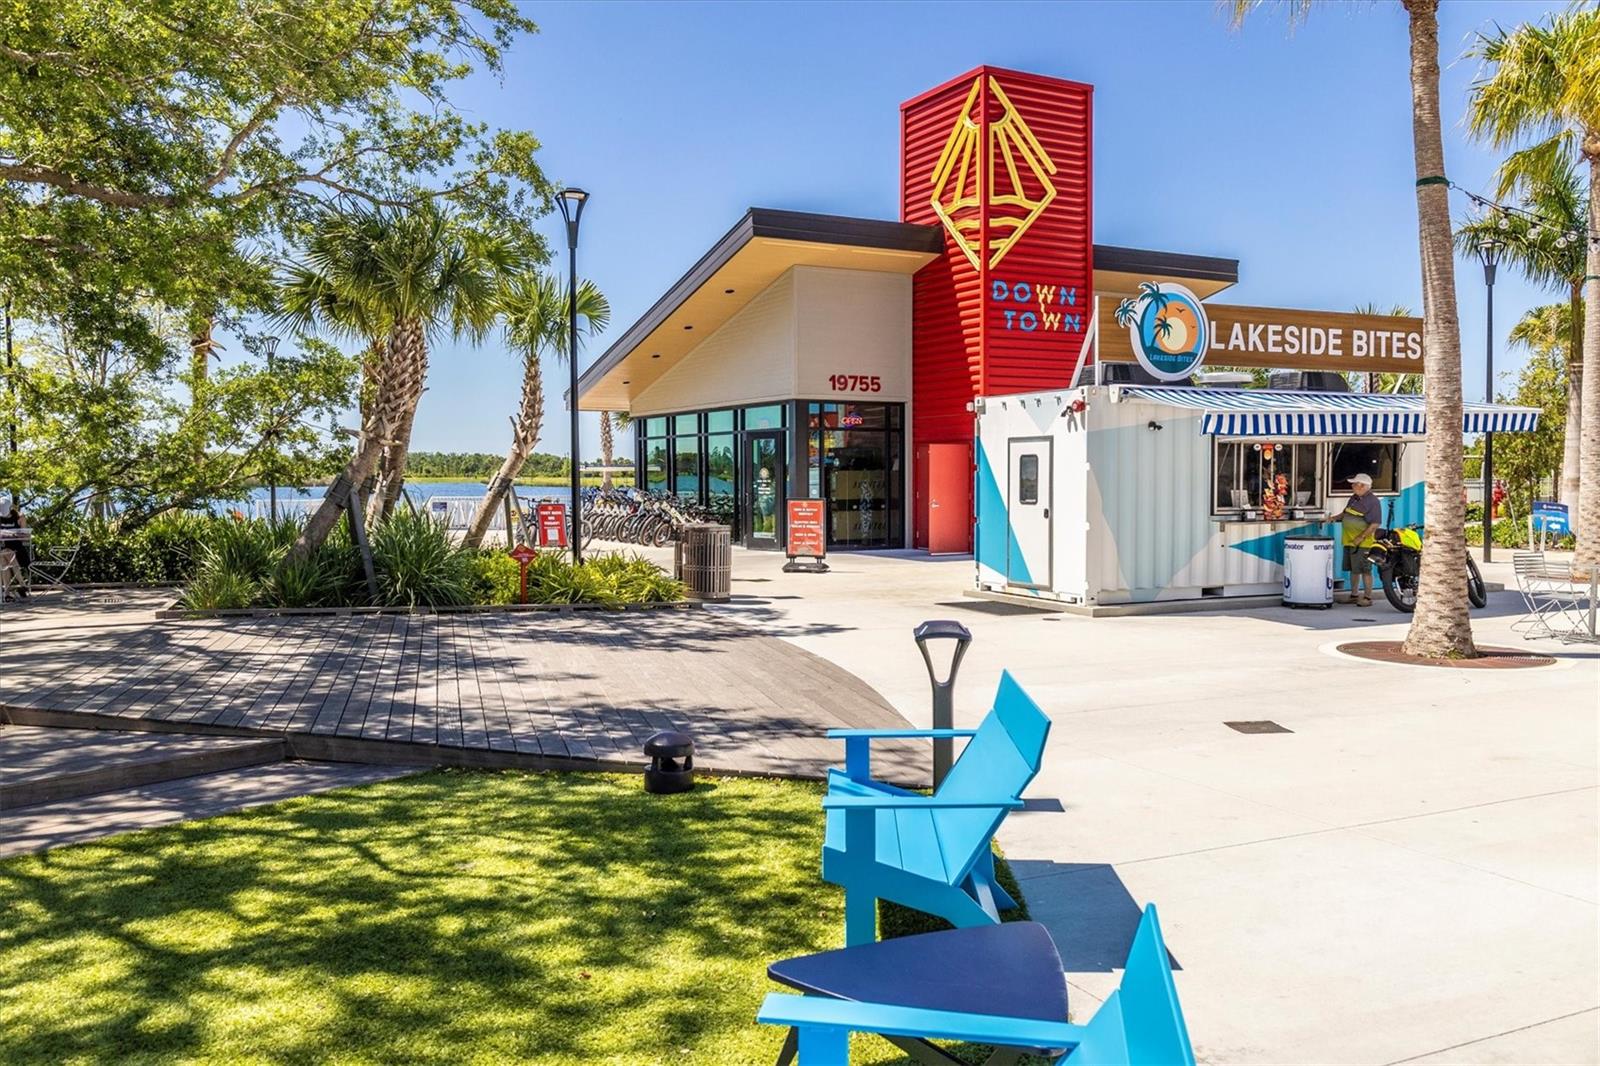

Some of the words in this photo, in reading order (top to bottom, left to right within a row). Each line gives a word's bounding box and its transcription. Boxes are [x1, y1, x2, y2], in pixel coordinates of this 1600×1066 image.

[992, 280, 1076, 306] DOWN
[1004, 310, 1081, 332] TOWN
[1210, 321, 1343, 356] LAKESIDE
[1353, 330, 1422, 360] BITES
[829, 374, 881, 392] 19755
[841, 416, 863, 425] OPEN
